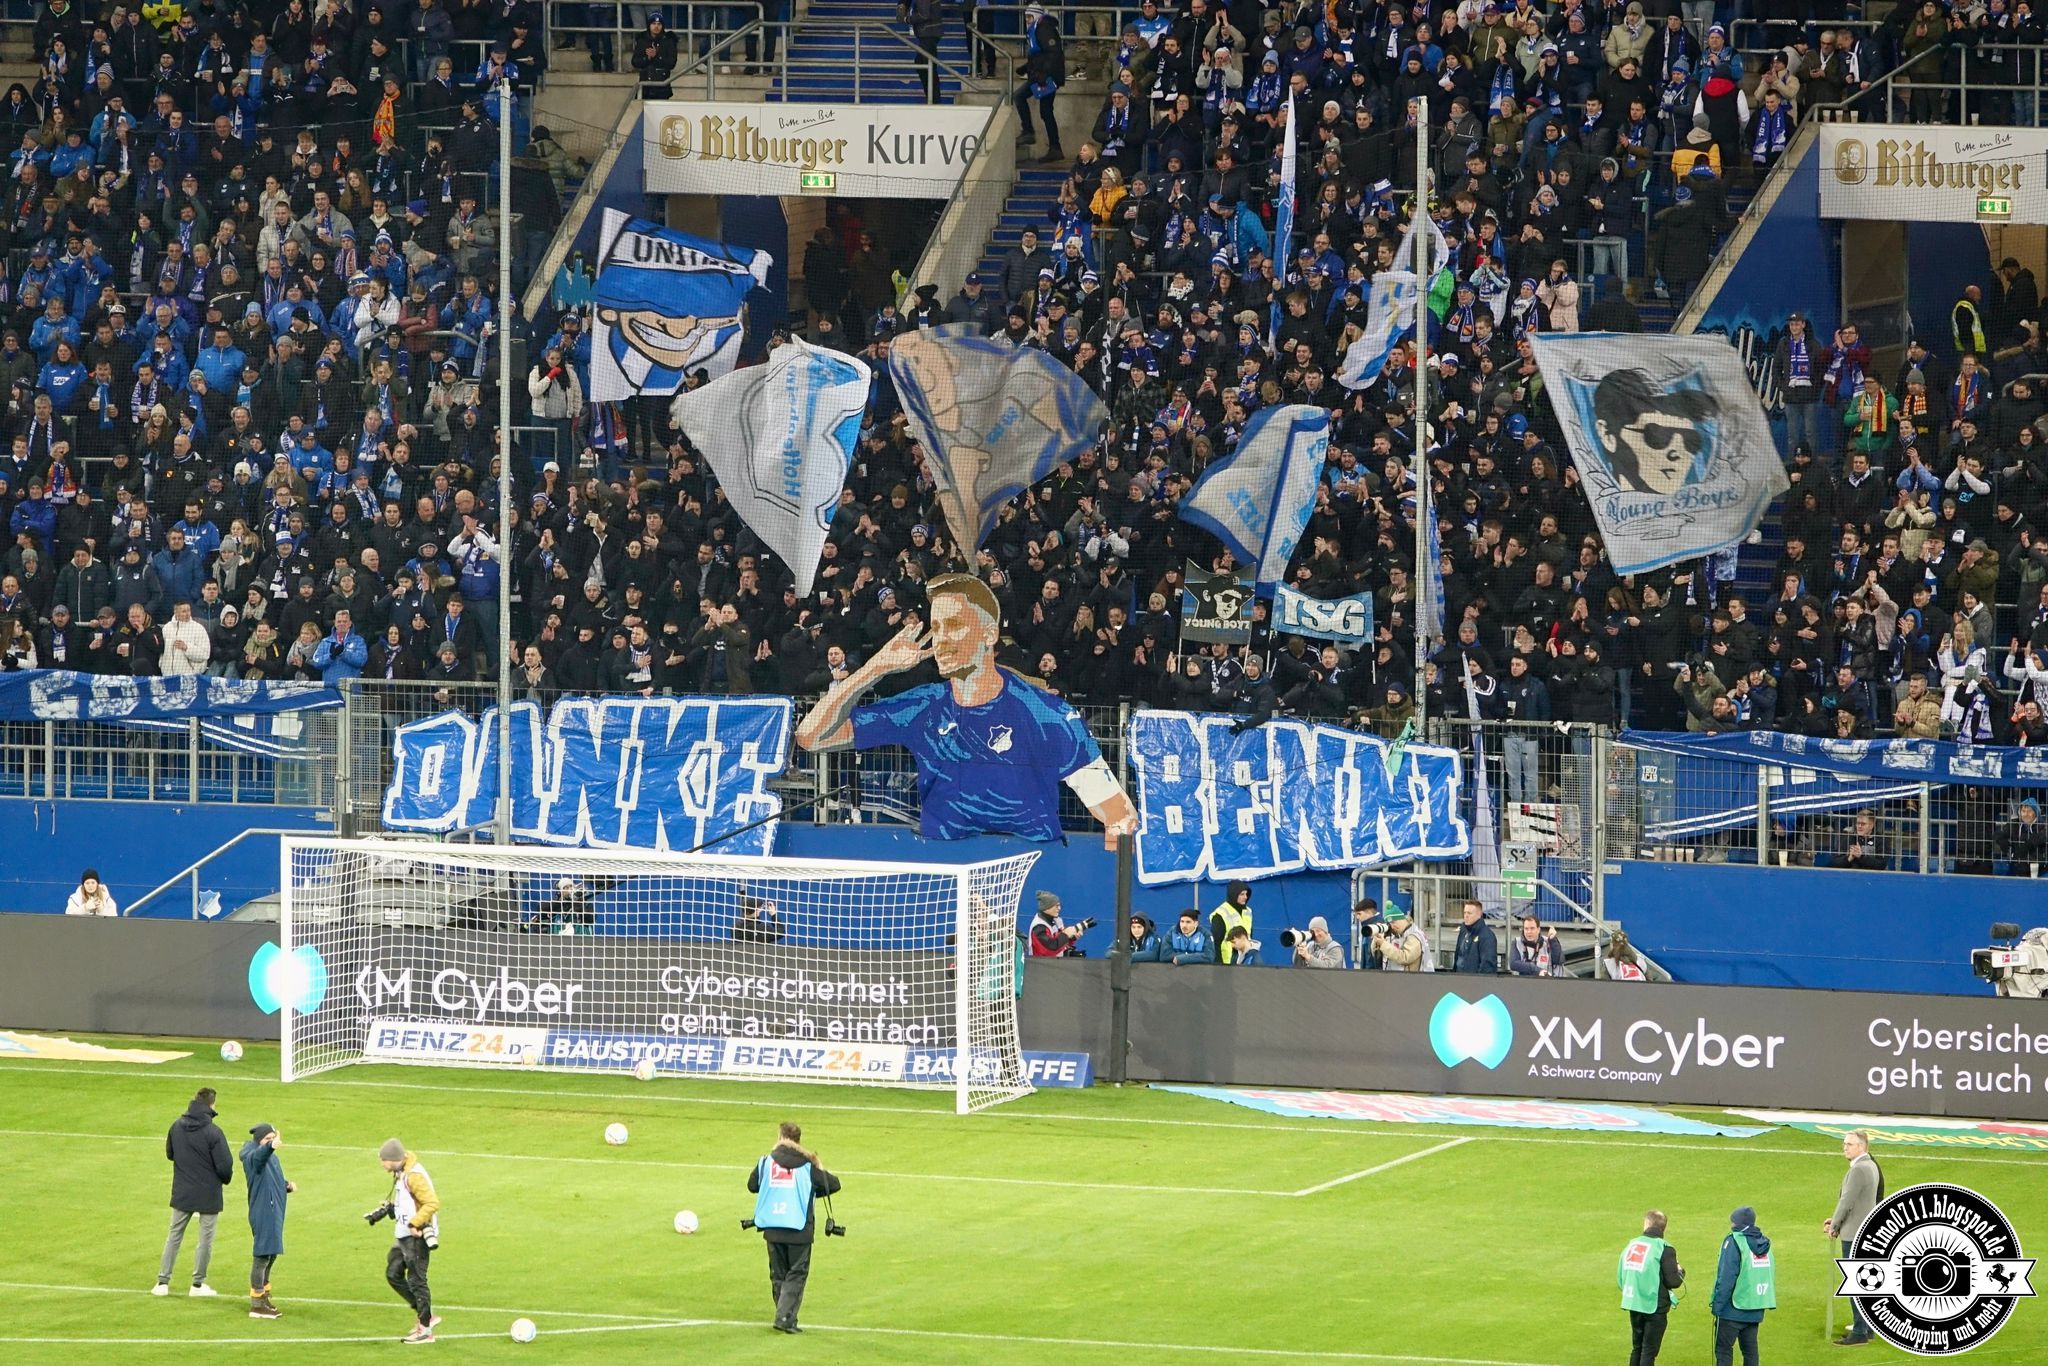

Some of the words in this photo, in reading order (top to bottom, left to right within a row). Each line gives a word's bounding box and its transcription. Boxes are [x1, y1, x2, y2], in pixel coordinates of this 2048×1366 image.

[818, 109, 835, 121] Bit
[699, 115, 848, 169] Bitburger
[867, 124, 979, 164] Kurve
[1995, 133, 2012, 145] Bit
[1873, 138, 2025, 196] Bitburger
[1606, 496, 1665, 524] Young
[1184, 618, 1222, 629] YOUNG
[1223, 619, 1250, 631] BOYZ
[1278, 587, 1366, 636] TSG
[1130, 709, 1474, 884] BENNI
[432, 966, 583, 1022] Cyber
[660, 966, 909, 1004] Cybersicherheit
[660, 1006, 731, 1037] geht
[827, 1012, 939, 1045] einfach
[1868, 1018, 2048, 1056] Cybersiche
[553, 1038, 715, 1065] BAUSTOFFE
[733, 1045, 892, 1073] BENZ24.DE
[1528, 1016, 1601, 1061] XM
[1625, 1018, 1785, 1076] Cyber
[1528, 1065, 1538, 1077] A
[1541, 1065, 1596, 1079] Schwarz
[1599, 1068, 1663, 1085] Company
[1867, 1058, 1943, 1095] geht
[1955, 1063, 2031, 1093] auch
[772, 1202, 787, 1214] 12
[1756, 1283, 1769, 1296] 07
